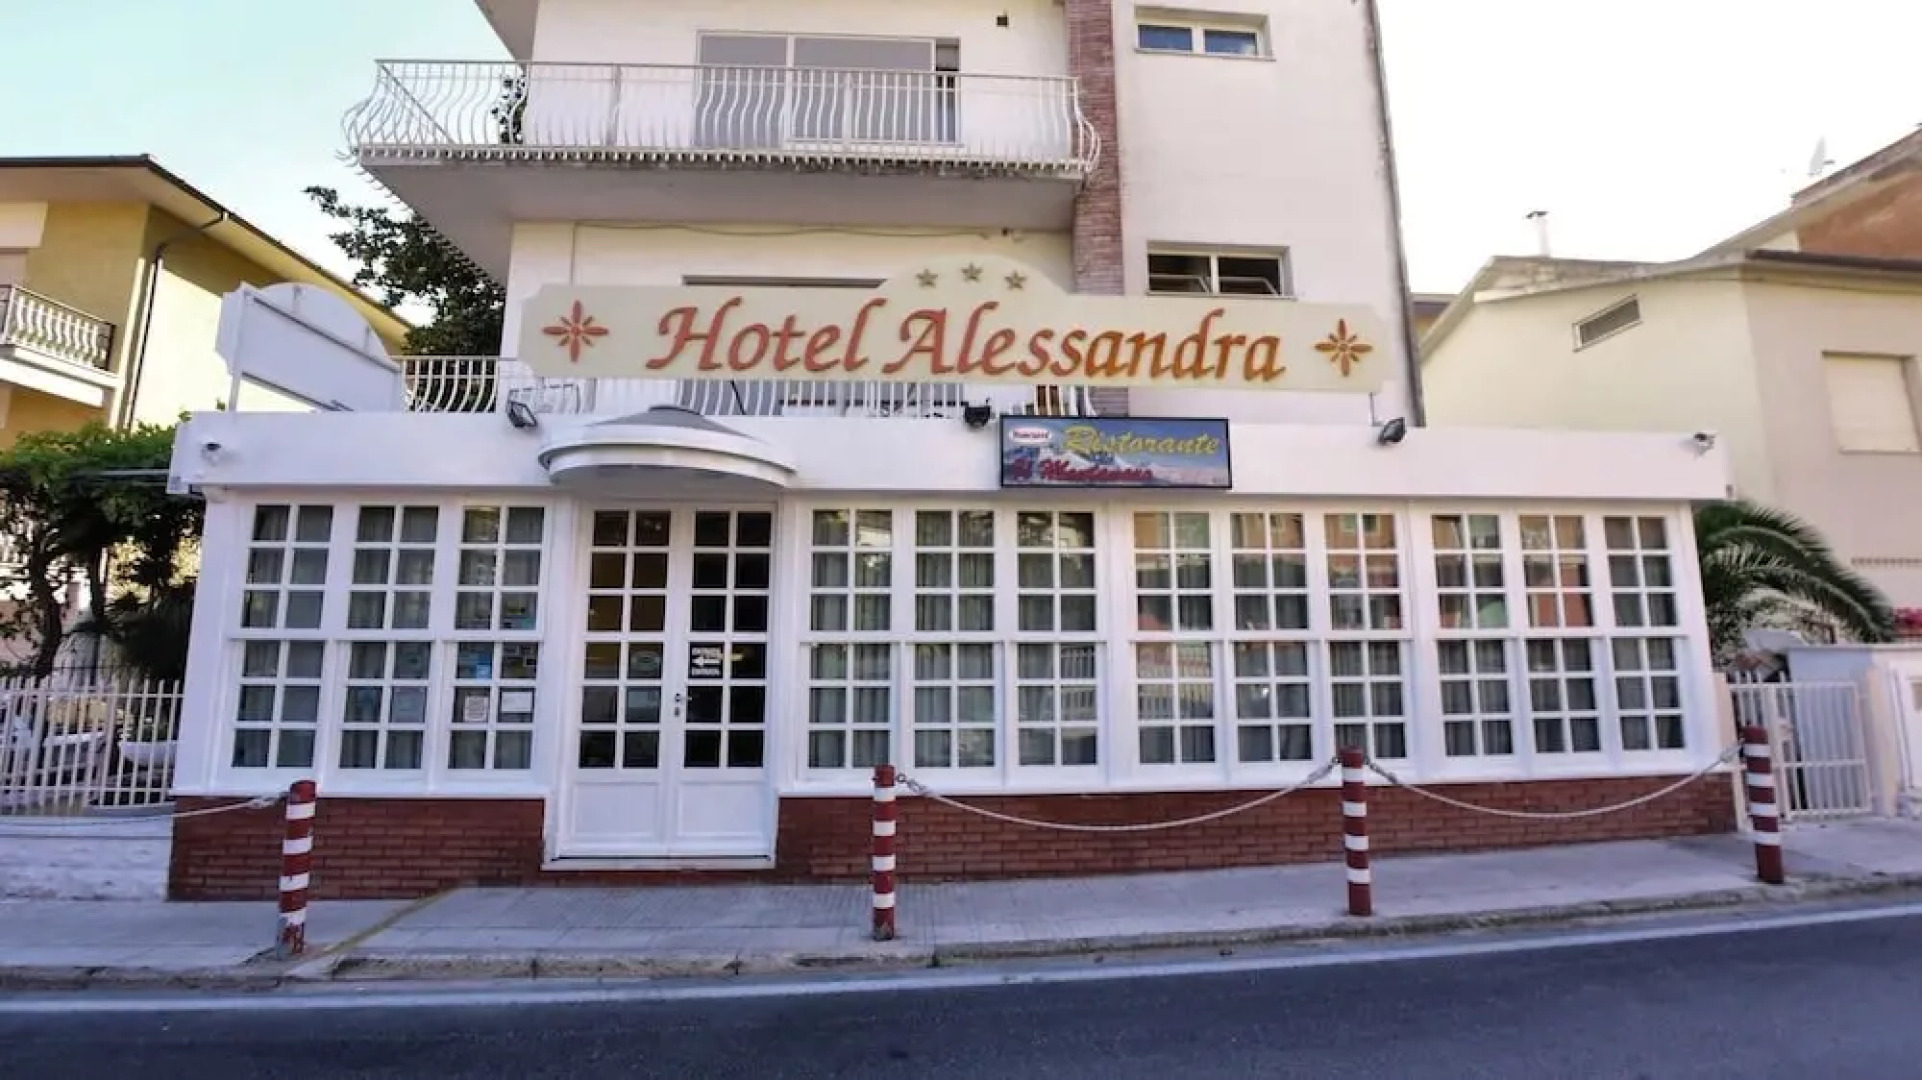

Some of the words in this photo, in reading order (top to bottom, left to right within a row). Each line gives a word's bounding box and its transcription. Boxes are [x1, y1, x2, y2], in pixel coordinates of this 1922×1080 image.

[645, 296, 888, 371] Hotel
[882, 300, 1287, 382] Alessandra
[1061, 425, 1220, 455] Ristorante
